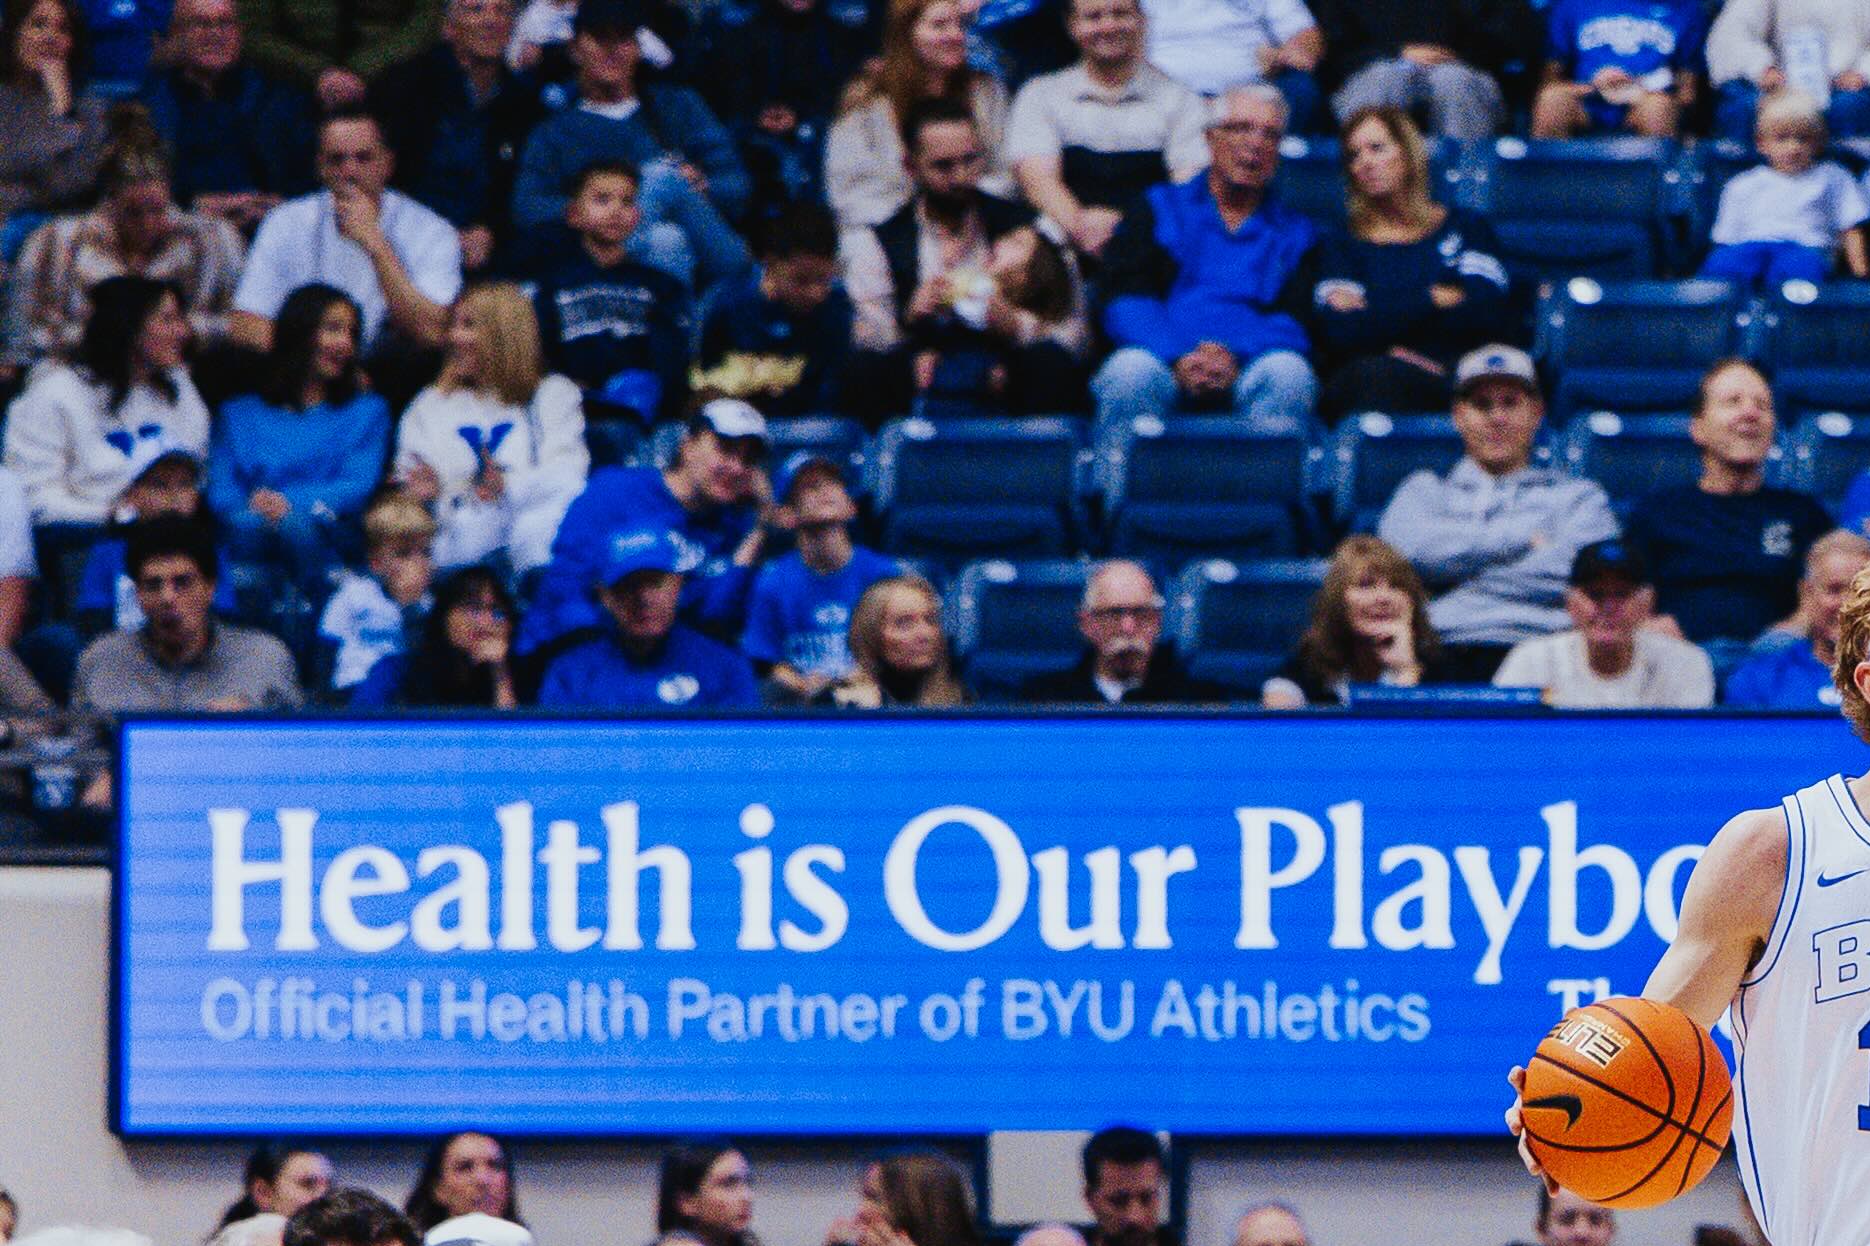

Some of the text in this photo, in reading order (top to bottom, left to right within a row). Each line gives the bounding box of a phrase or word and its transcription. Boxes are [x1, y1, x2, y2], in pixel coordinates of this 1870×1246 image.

[207, 801, 696, 952] Health
[734, 803, 849, 952] is
[884, 805, 1196, 952] Our
[201, 977, 1431, 1042] Official Health Partner of BYU Athletics
